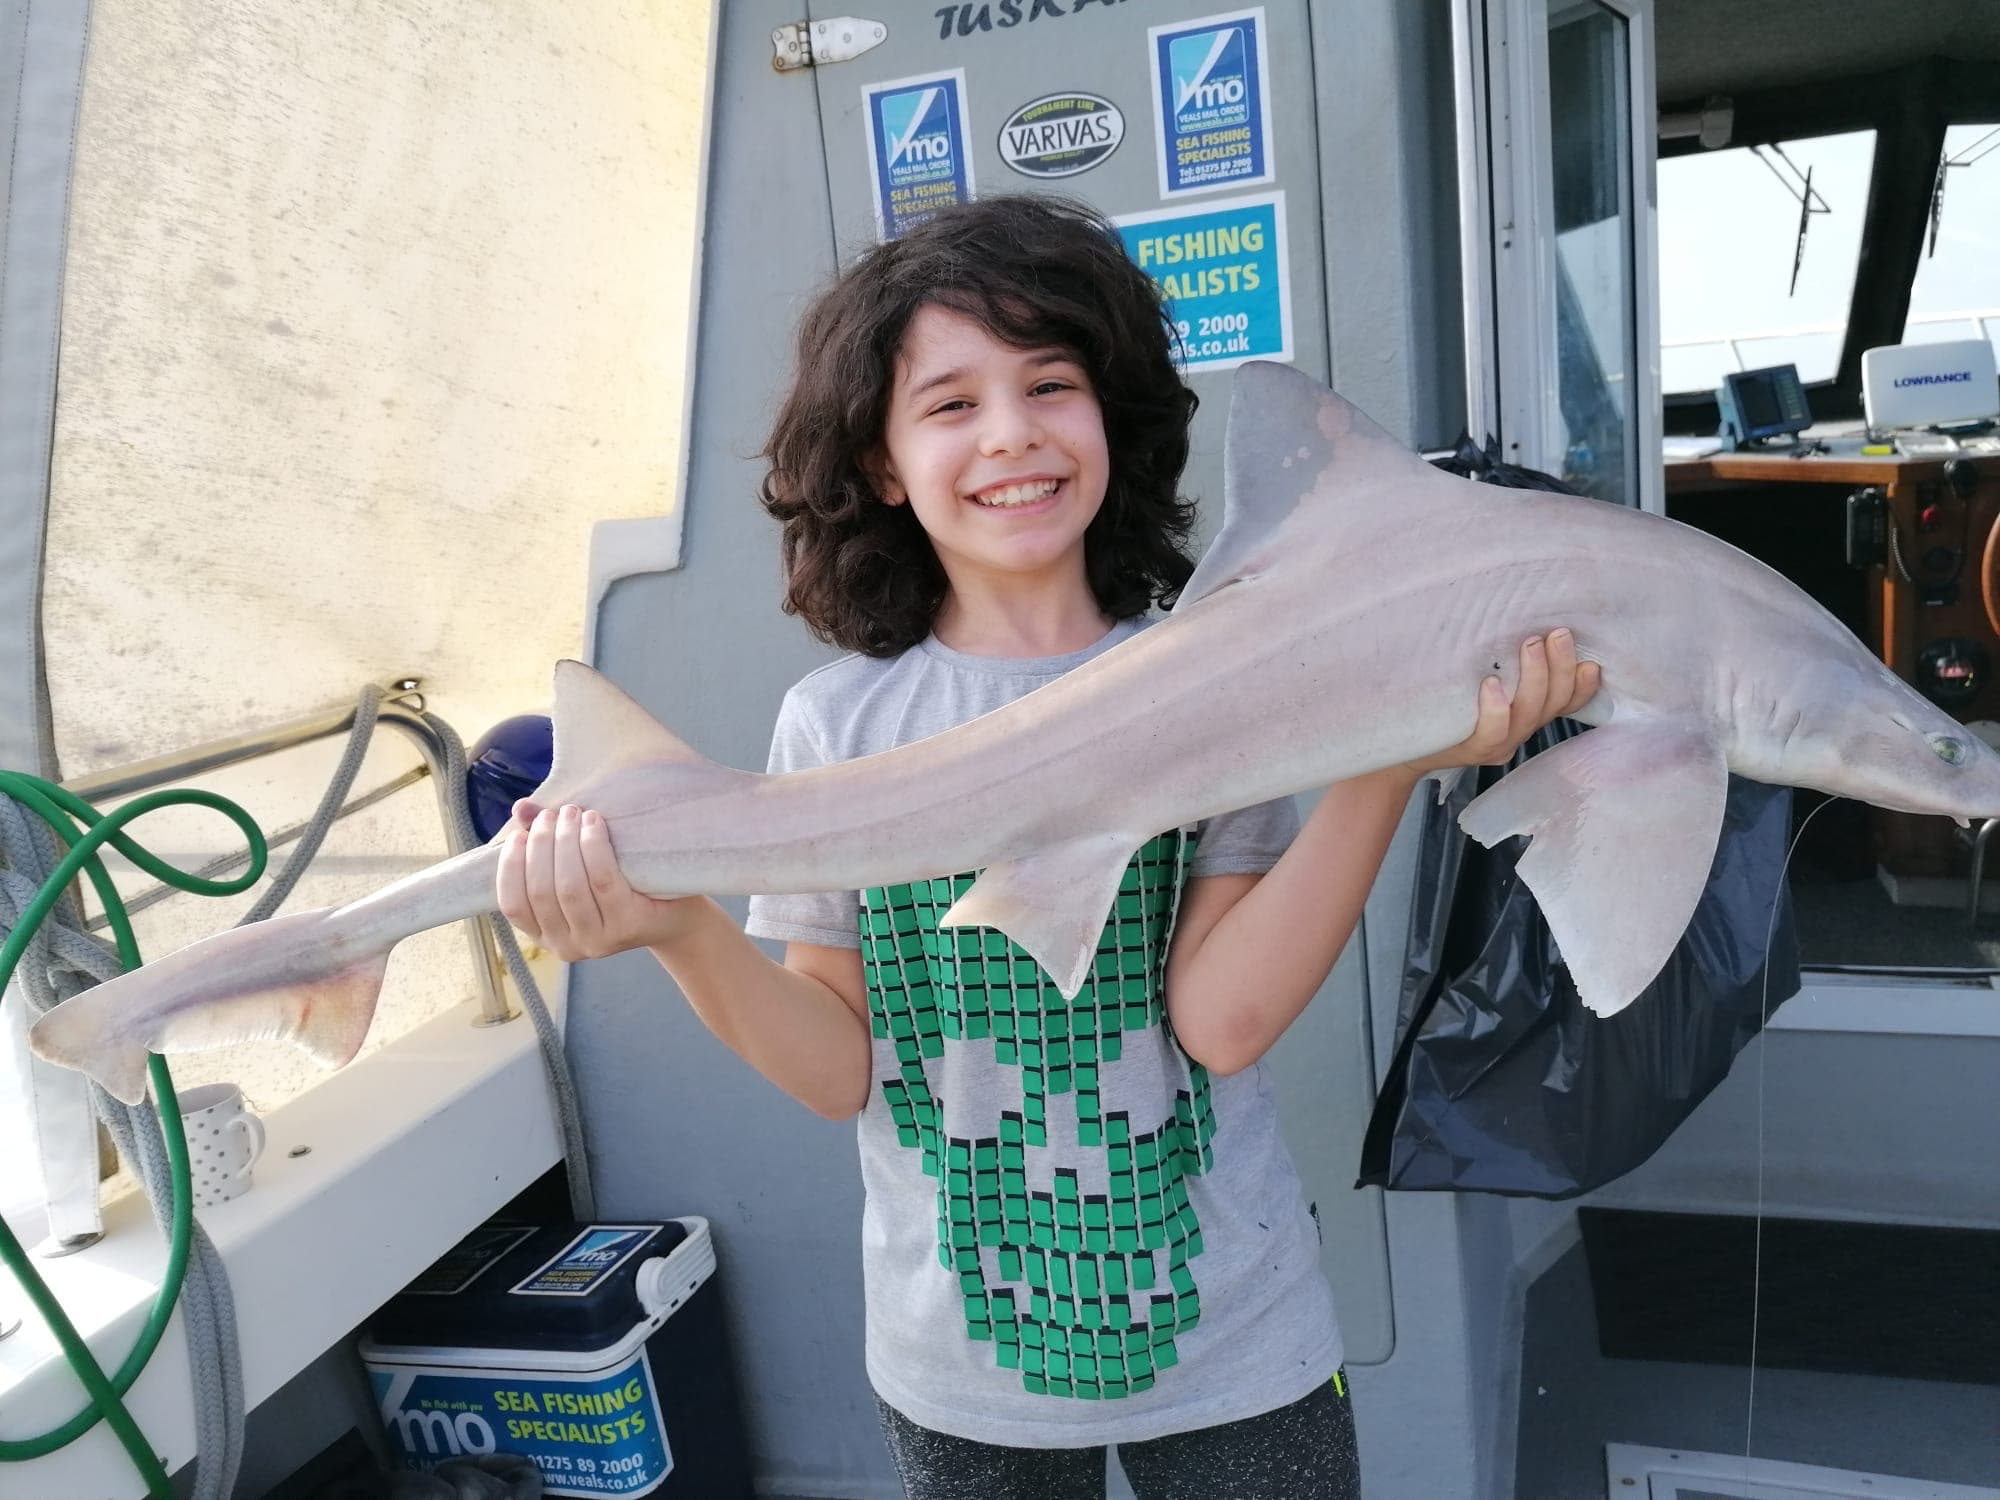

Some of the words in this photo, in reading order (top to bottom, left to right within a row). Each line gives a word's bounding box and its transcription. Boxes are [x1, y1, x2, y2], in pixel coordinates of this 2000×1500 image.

[934, 0, 1130, 40] TUSK
[1179, 112, 1201, 123] VEALS
[1202, 109, 1219, 120] MAIL
[1220, 104, 1245, 116] ORDER
[1008, 115, 1111, 155] VARIVAS
[1176, 136, 1200, 151] SEA
[1202, 127, 1251, 147] FISHING
[1178, 141, 1252, 165] SPECIALISTS
[890, 187, 911, 202] SEA
[913, 180, 956, 198] FISHING
[1138, 222, 1264, 267] FISHING
[1161, 263, 1261, 301] ALISTS
[1198, 312, 1248, 336] 2000
[1168, 332, 1250, 358] als.co.uk
[1894, 371, 1972, 388] LOWRANCE
[494, 1390, 540, 1413] SEA
[542, 1377, 643, 1416] FISHING
[506, 1410, 646, 1445] SPECIALISTS
[577, 1458, 596, 1473] 89
[600, 1453, 644, 1474] 2000
[543, 1469, 648, 1490] ww.veals.co.uk
